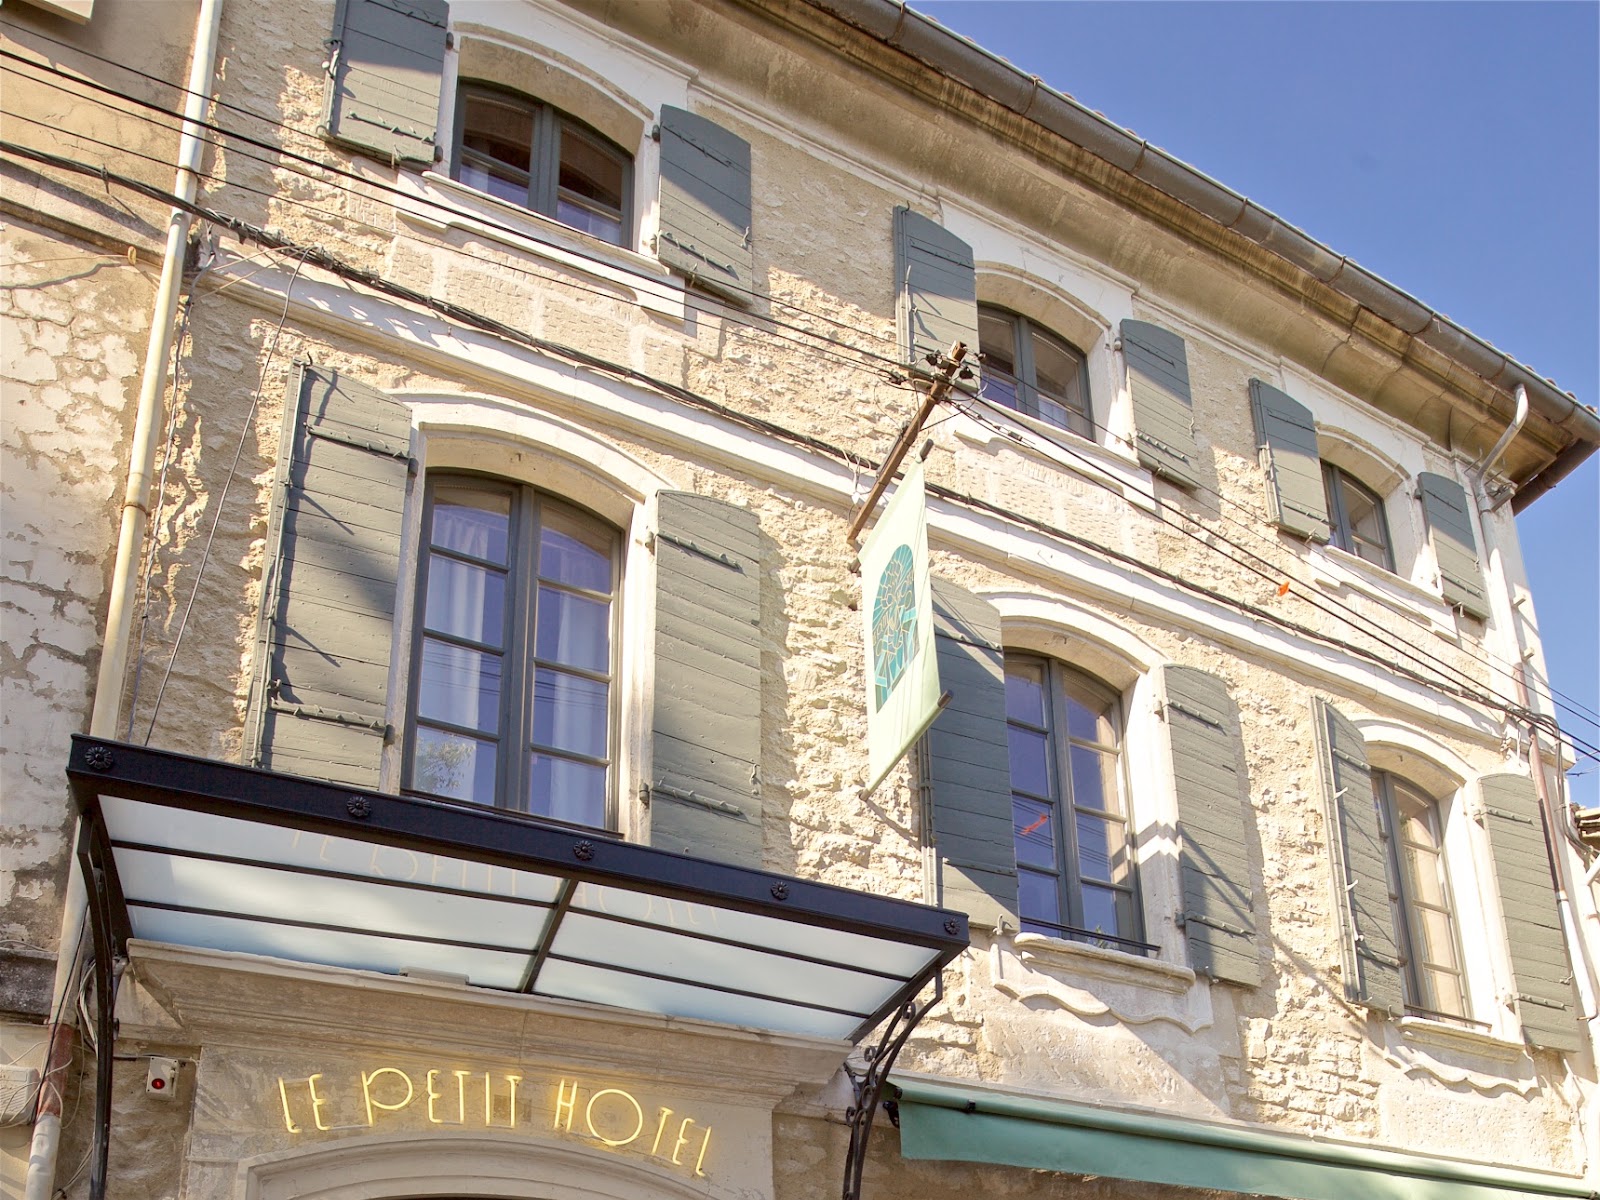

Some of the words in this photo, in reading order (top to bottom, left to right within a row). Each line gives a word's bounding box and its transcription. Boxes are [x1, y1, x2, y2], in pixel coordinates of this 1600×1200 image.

[277, 1073, 331, 1134] LE
[361, 1067, 523, 1129] PETIT
[553, 1077, 713, 1178] HOTEL
